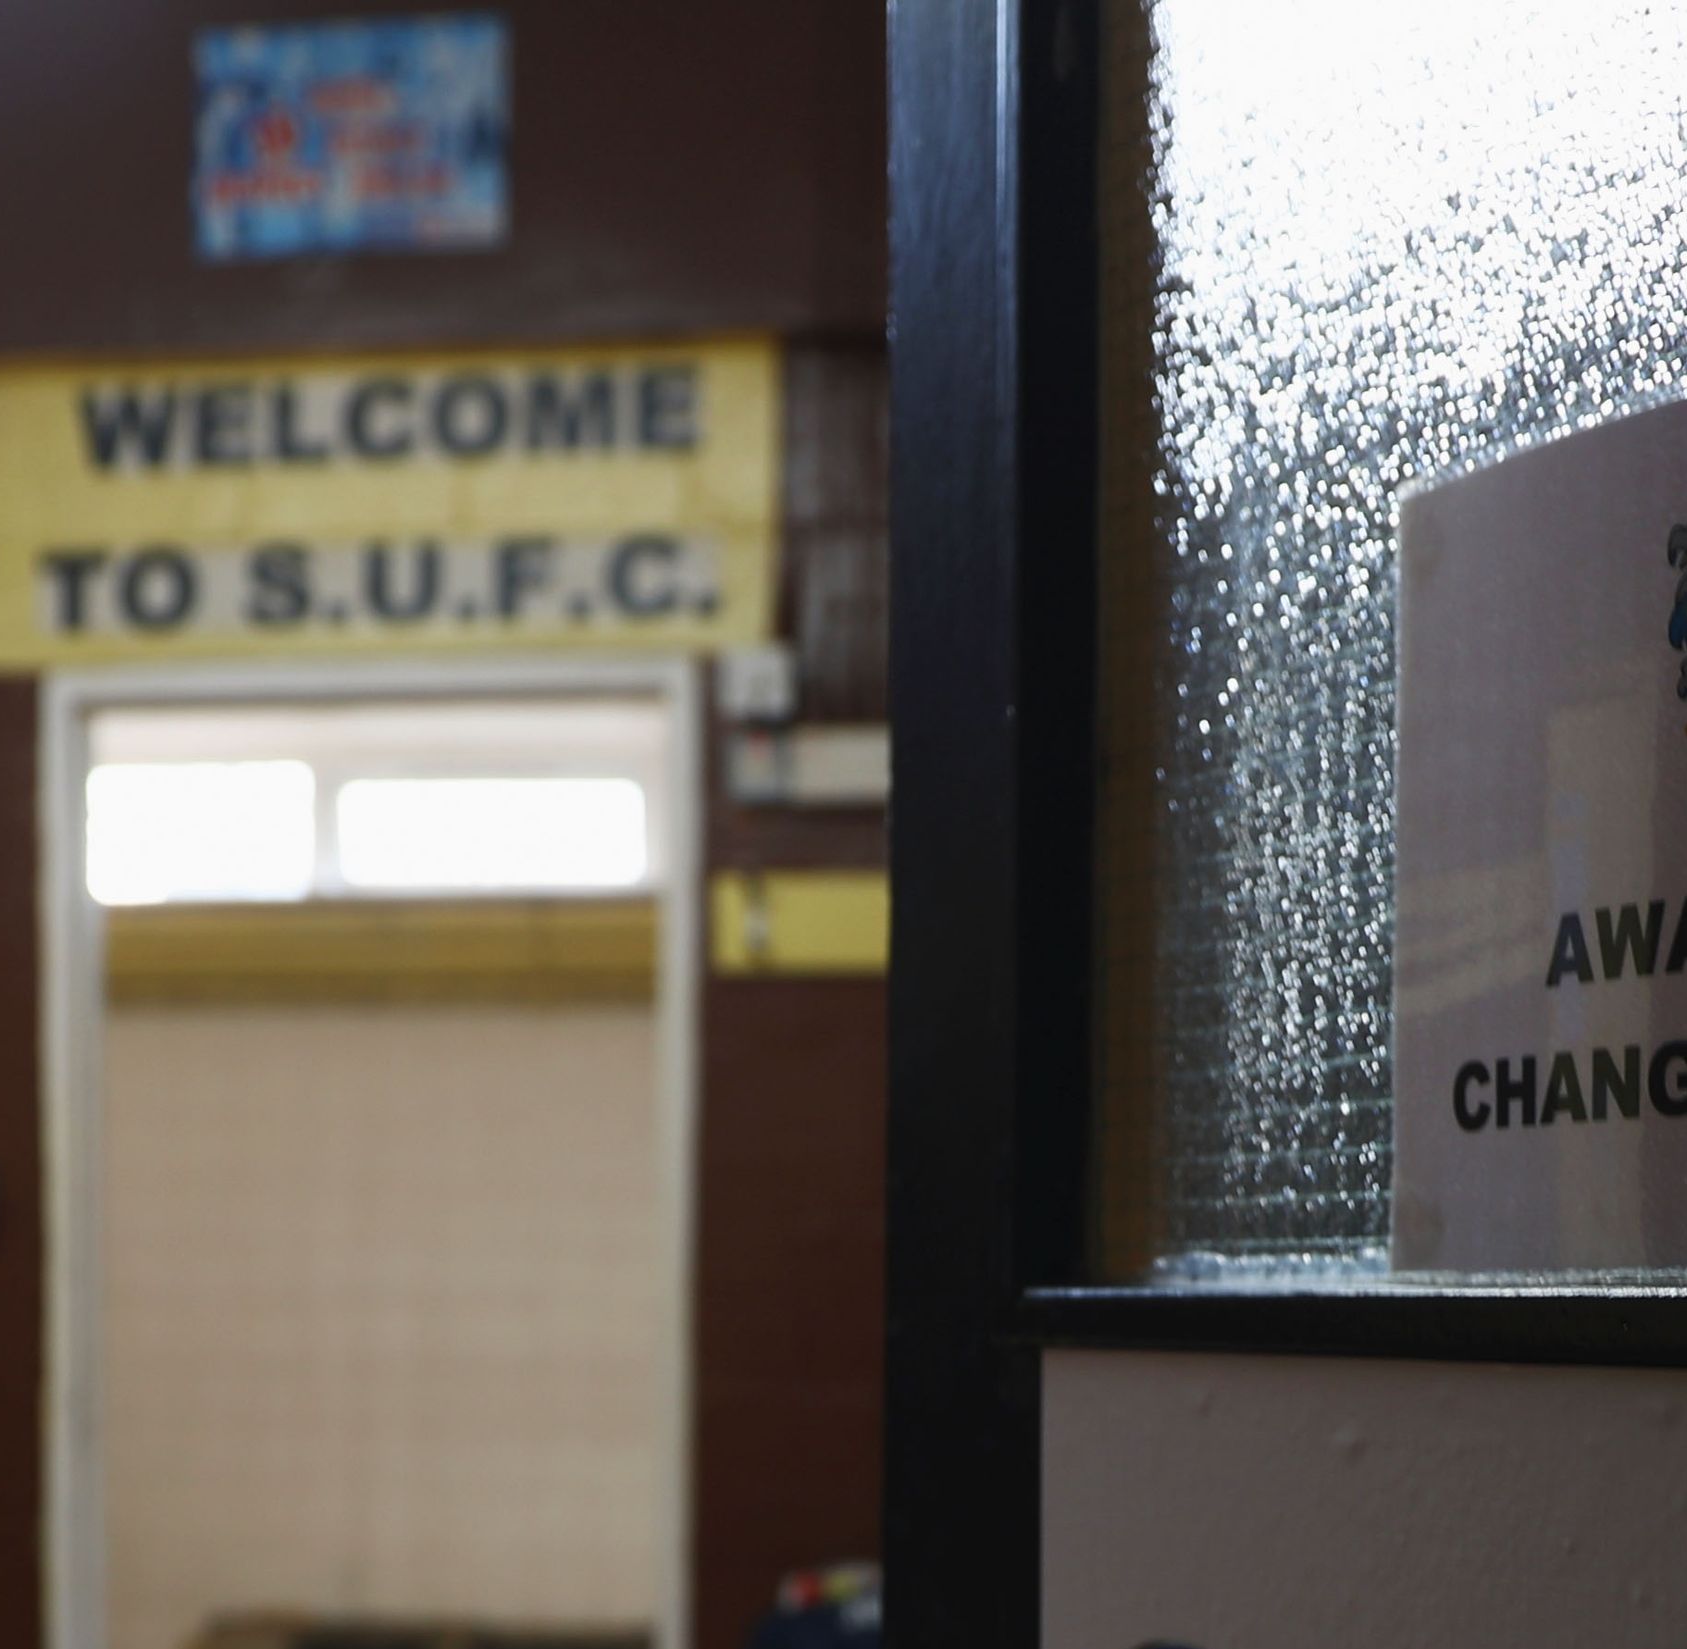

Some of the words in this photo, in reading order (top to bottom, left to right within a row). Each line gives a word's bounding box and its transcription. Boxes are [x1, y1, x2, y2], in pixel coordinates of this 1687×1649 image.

[80, 366, 700, 472] WELCOME
[41, 549, 196, 632] TO
[248, 537, 724, 628] S.U.F.C.
